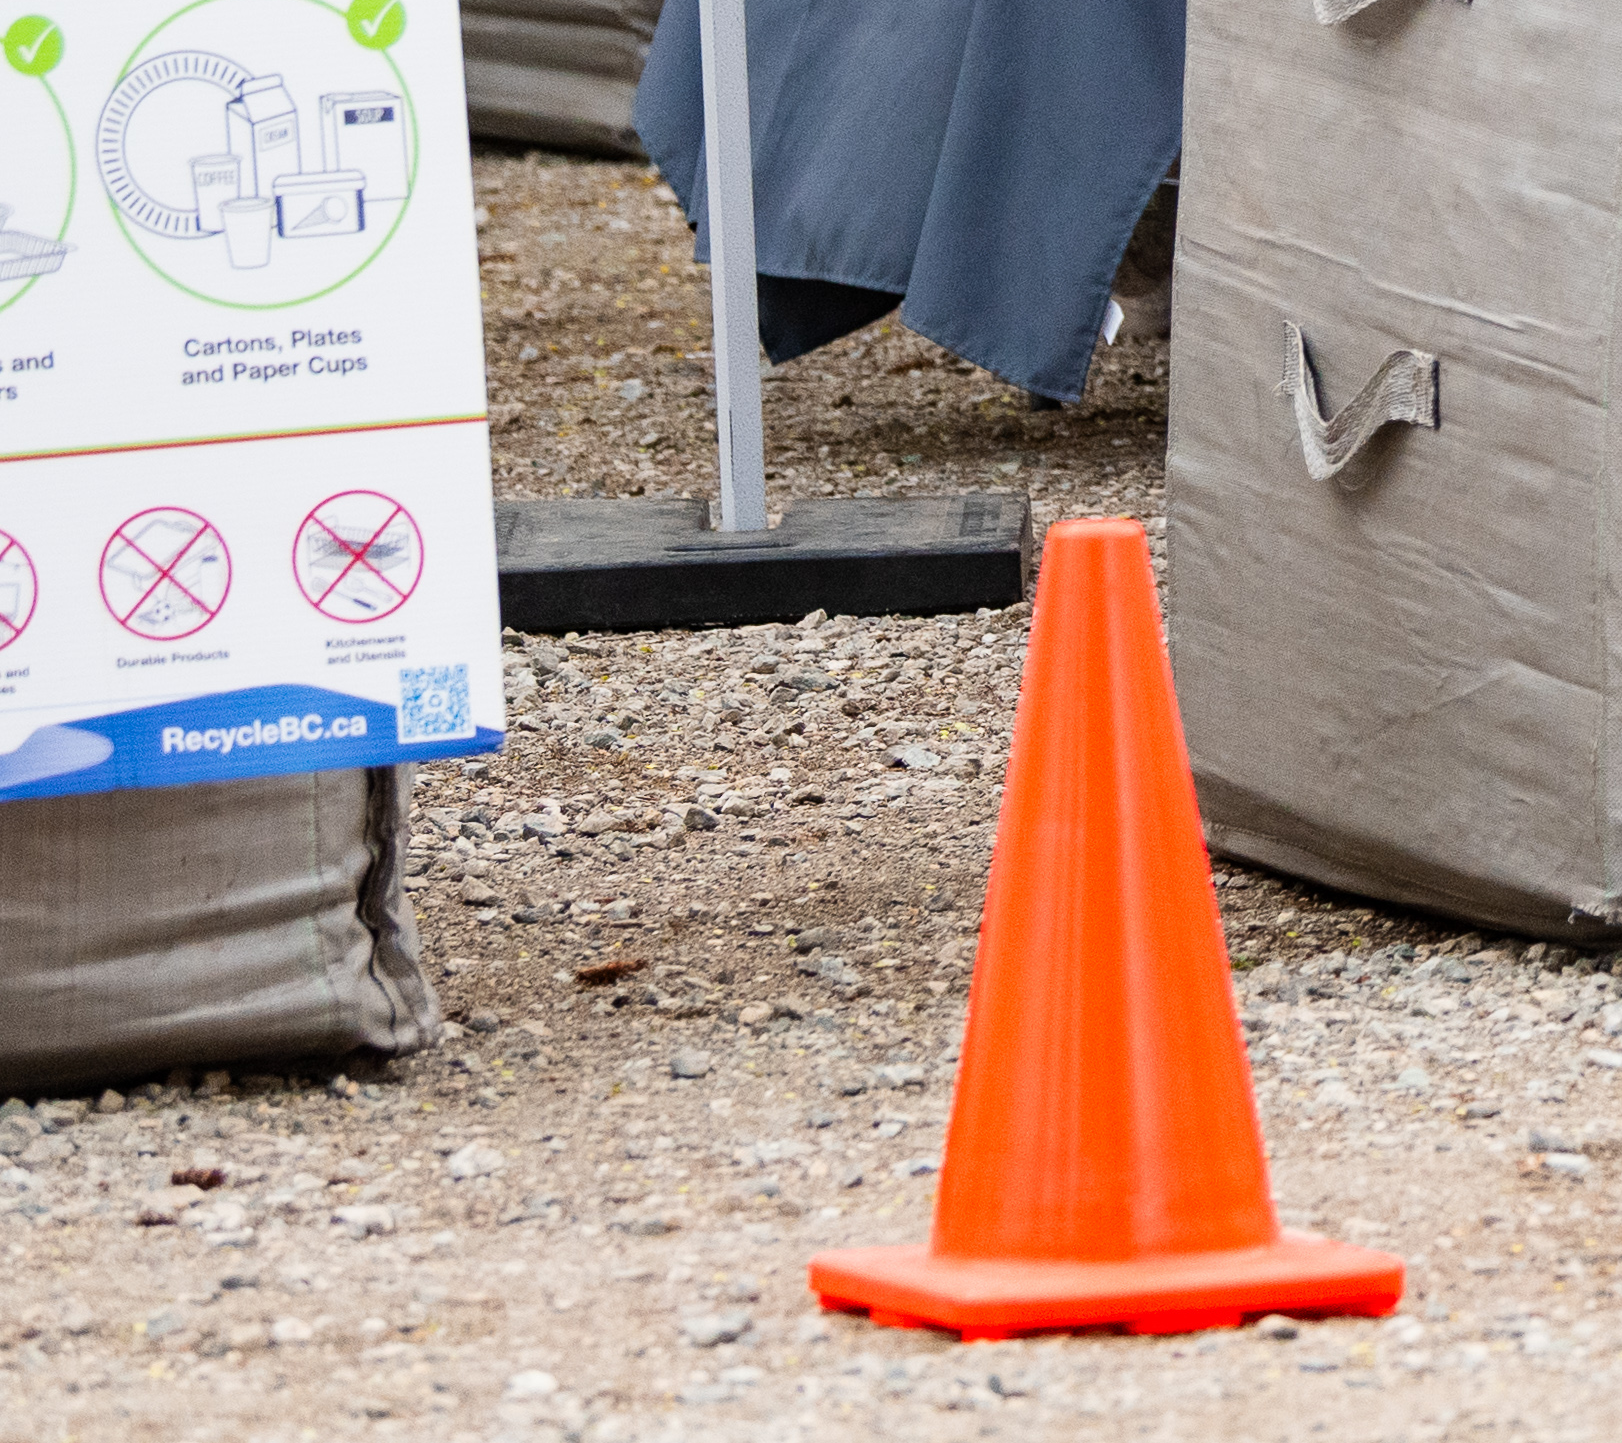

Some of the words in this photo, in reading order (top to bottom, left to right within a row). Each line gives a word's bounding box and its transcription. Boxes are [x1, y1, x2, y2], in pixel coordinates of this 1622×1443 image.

[184, 332, 284, 358] Cartons,
[291, 327, 362, 348] Plates
[11, 351, 54, 373] and
[181, 364, 224, 385] and
[232, 359, 299, 384] Paper
[308, 352, 368, 376] Cups
[325, 635, 406, 649] Kitchenware
[117, 654, 167, 669] Durable
[171, 650, 230, 664] Products
[327, 653, 352, 665] and
[355, 649, 406, 663] Utensils
[6, 666, 30, 678] and
[162, 715, 367, 754] RecycleBC.ca
